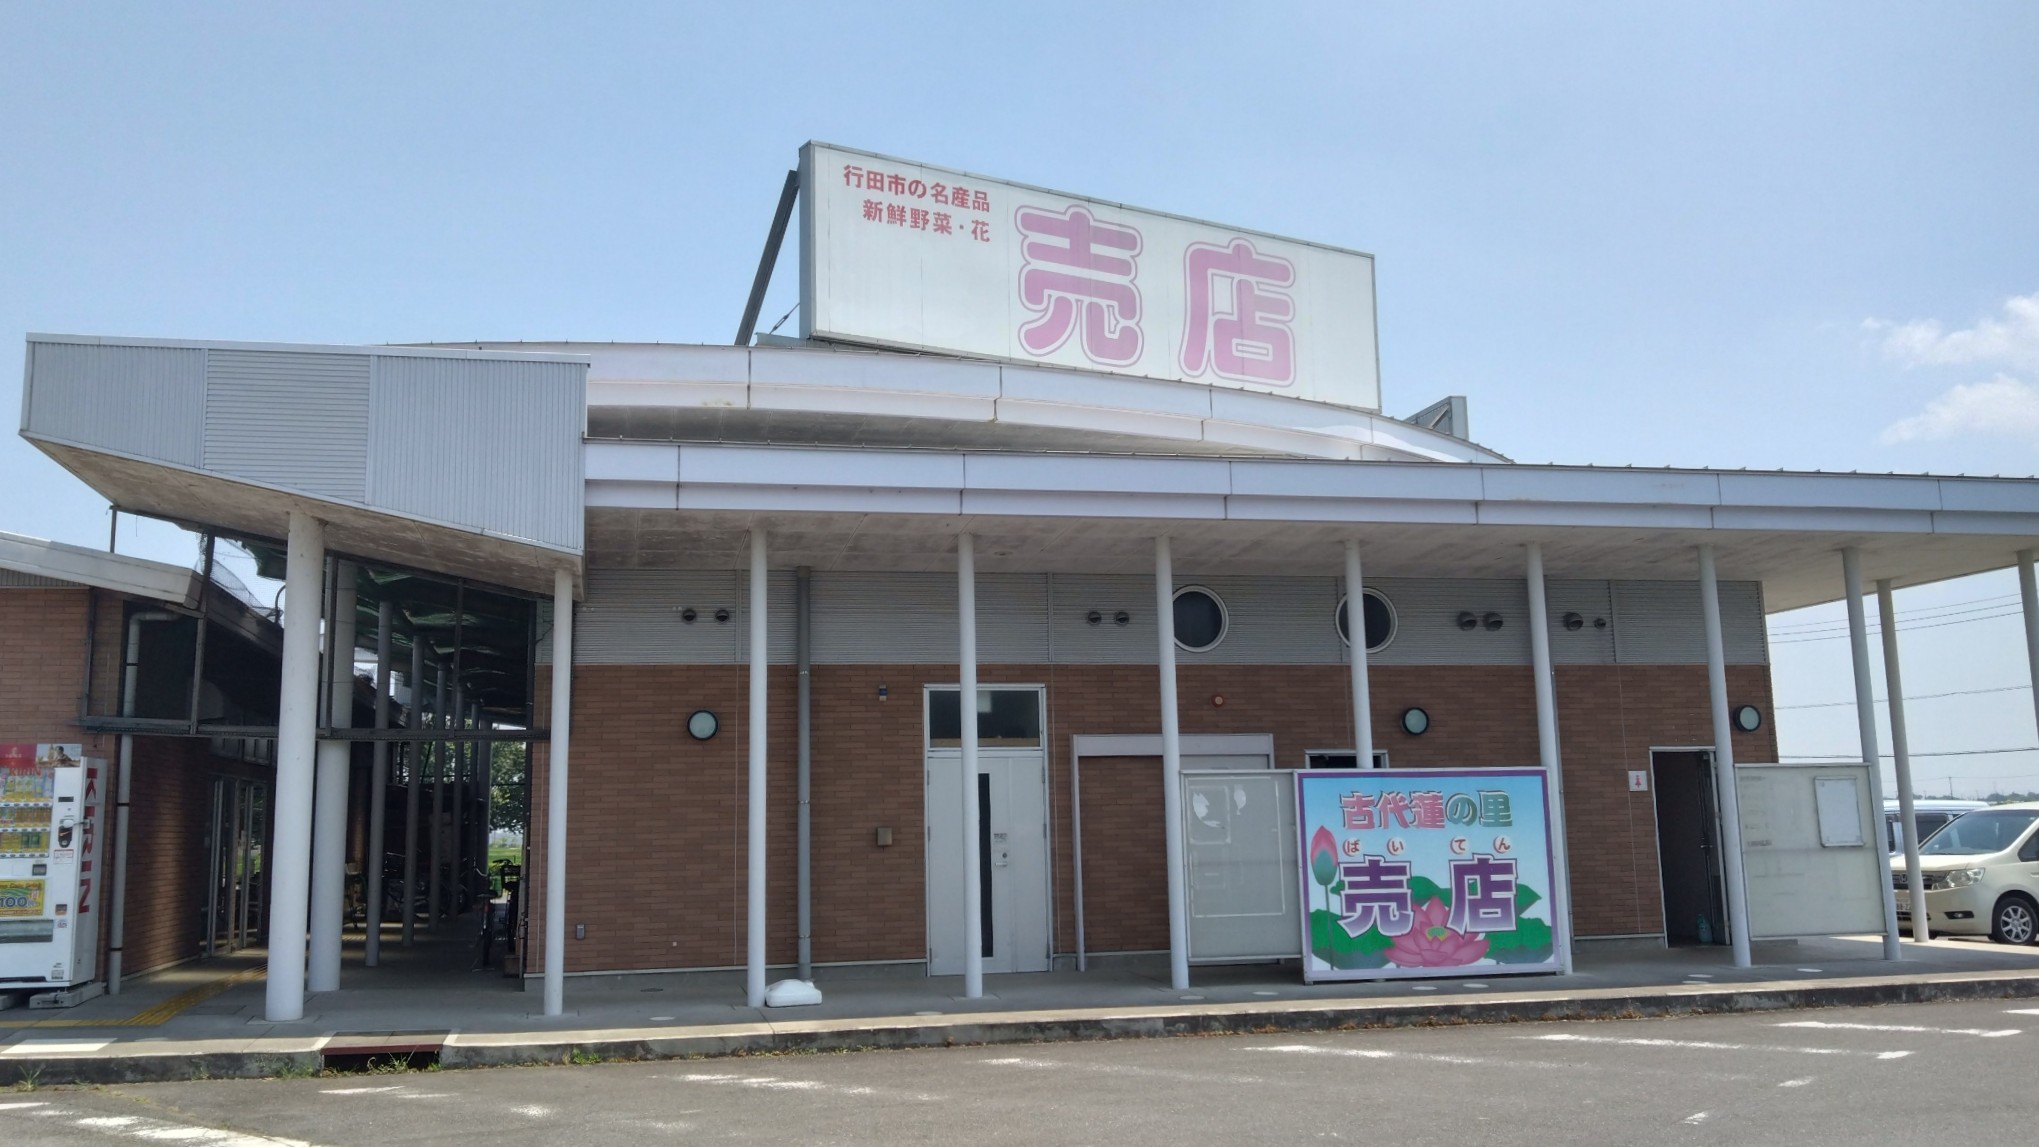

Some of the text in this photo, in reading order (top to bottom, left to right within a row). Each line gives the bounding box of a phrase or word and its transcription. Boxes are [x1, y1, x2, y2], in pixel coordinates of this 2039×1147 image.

[843, 164, 990, 213] 行田市の名産品
[862, 198, 990, 243] 新鮮野菜・花
[1015, 205, 1297, 388] 売店
[1340, 790, 1513, 830] 古代蓮の里
[1337, 853, 1518, 939] 売店
